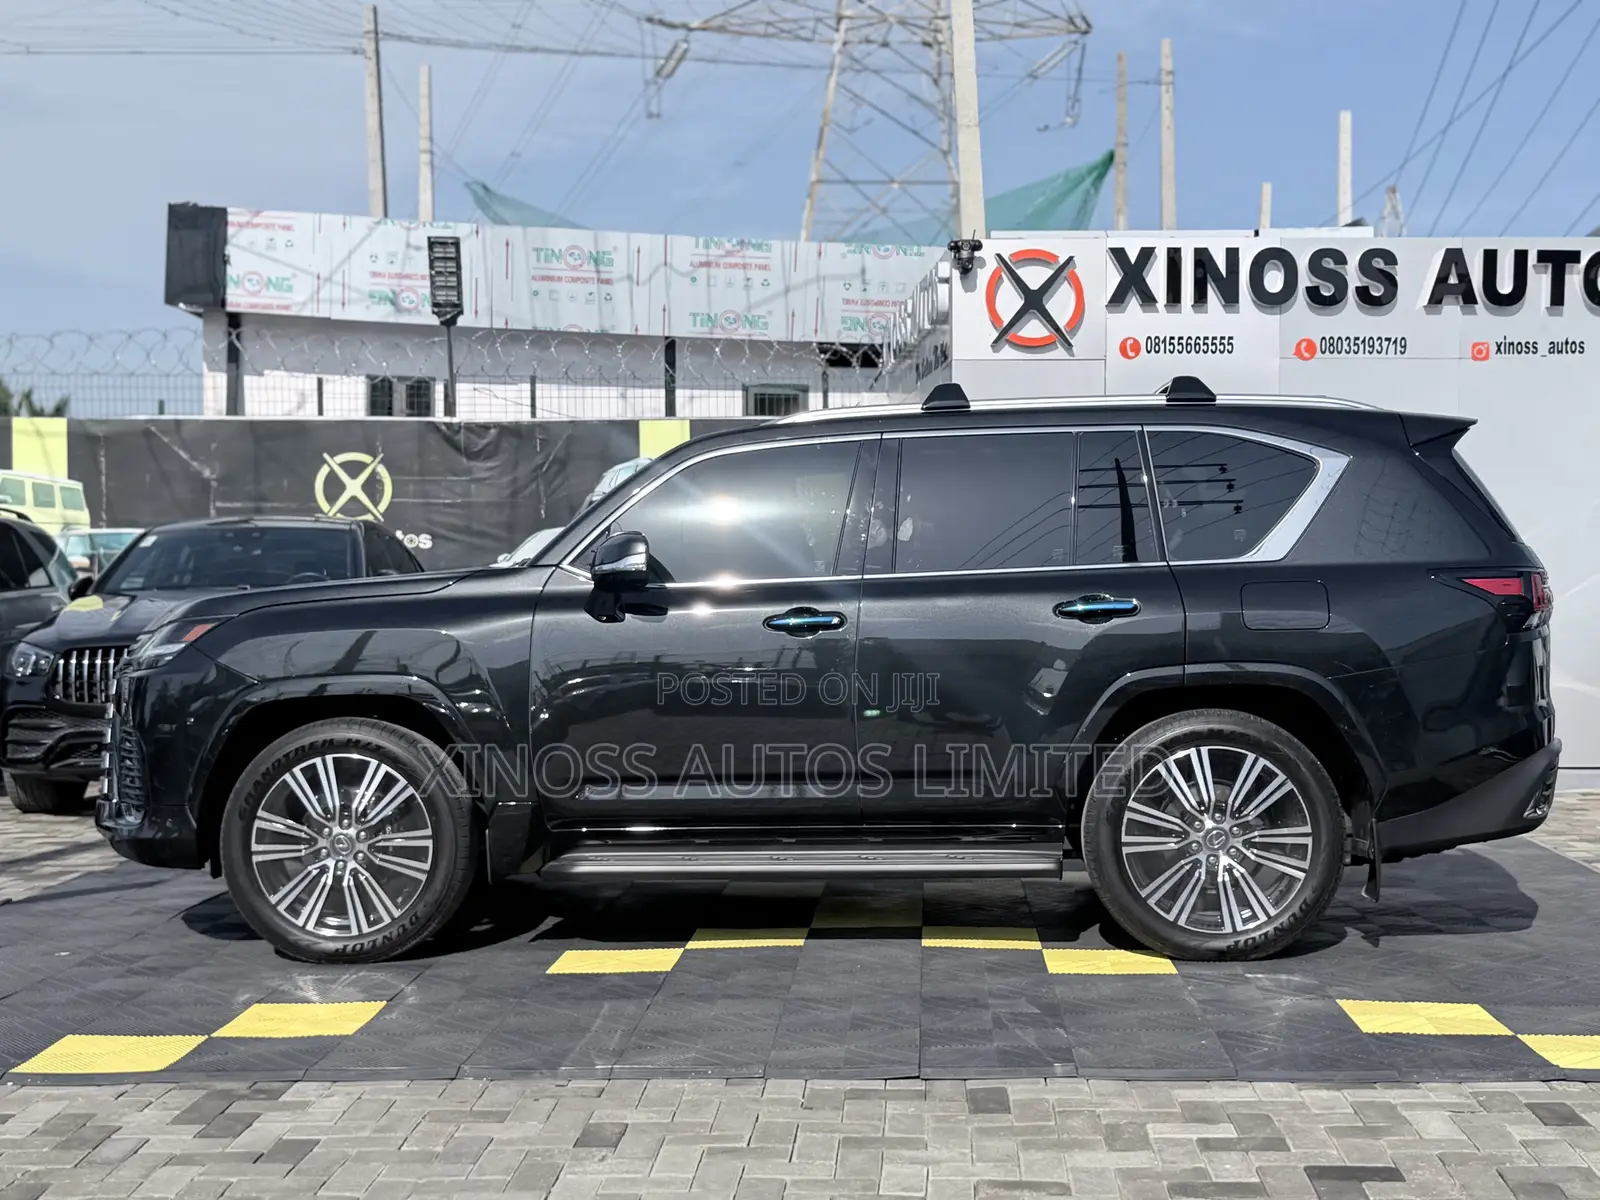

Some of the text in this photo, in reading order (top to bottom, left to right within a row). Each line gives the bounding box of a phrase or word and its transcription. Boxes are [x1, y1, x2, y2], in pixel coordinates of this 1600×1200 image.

[1106, 246, 1399, 307] XINOSS
[1145, 335, 1234, 355] 08155665555
[1319, 336, 1408, 355] 08035193719
[395, 529, 433, 549] tos
[334, 911, 419, 953] DUNLOP
[1225, 897, 1311, 952] DUNLOP
